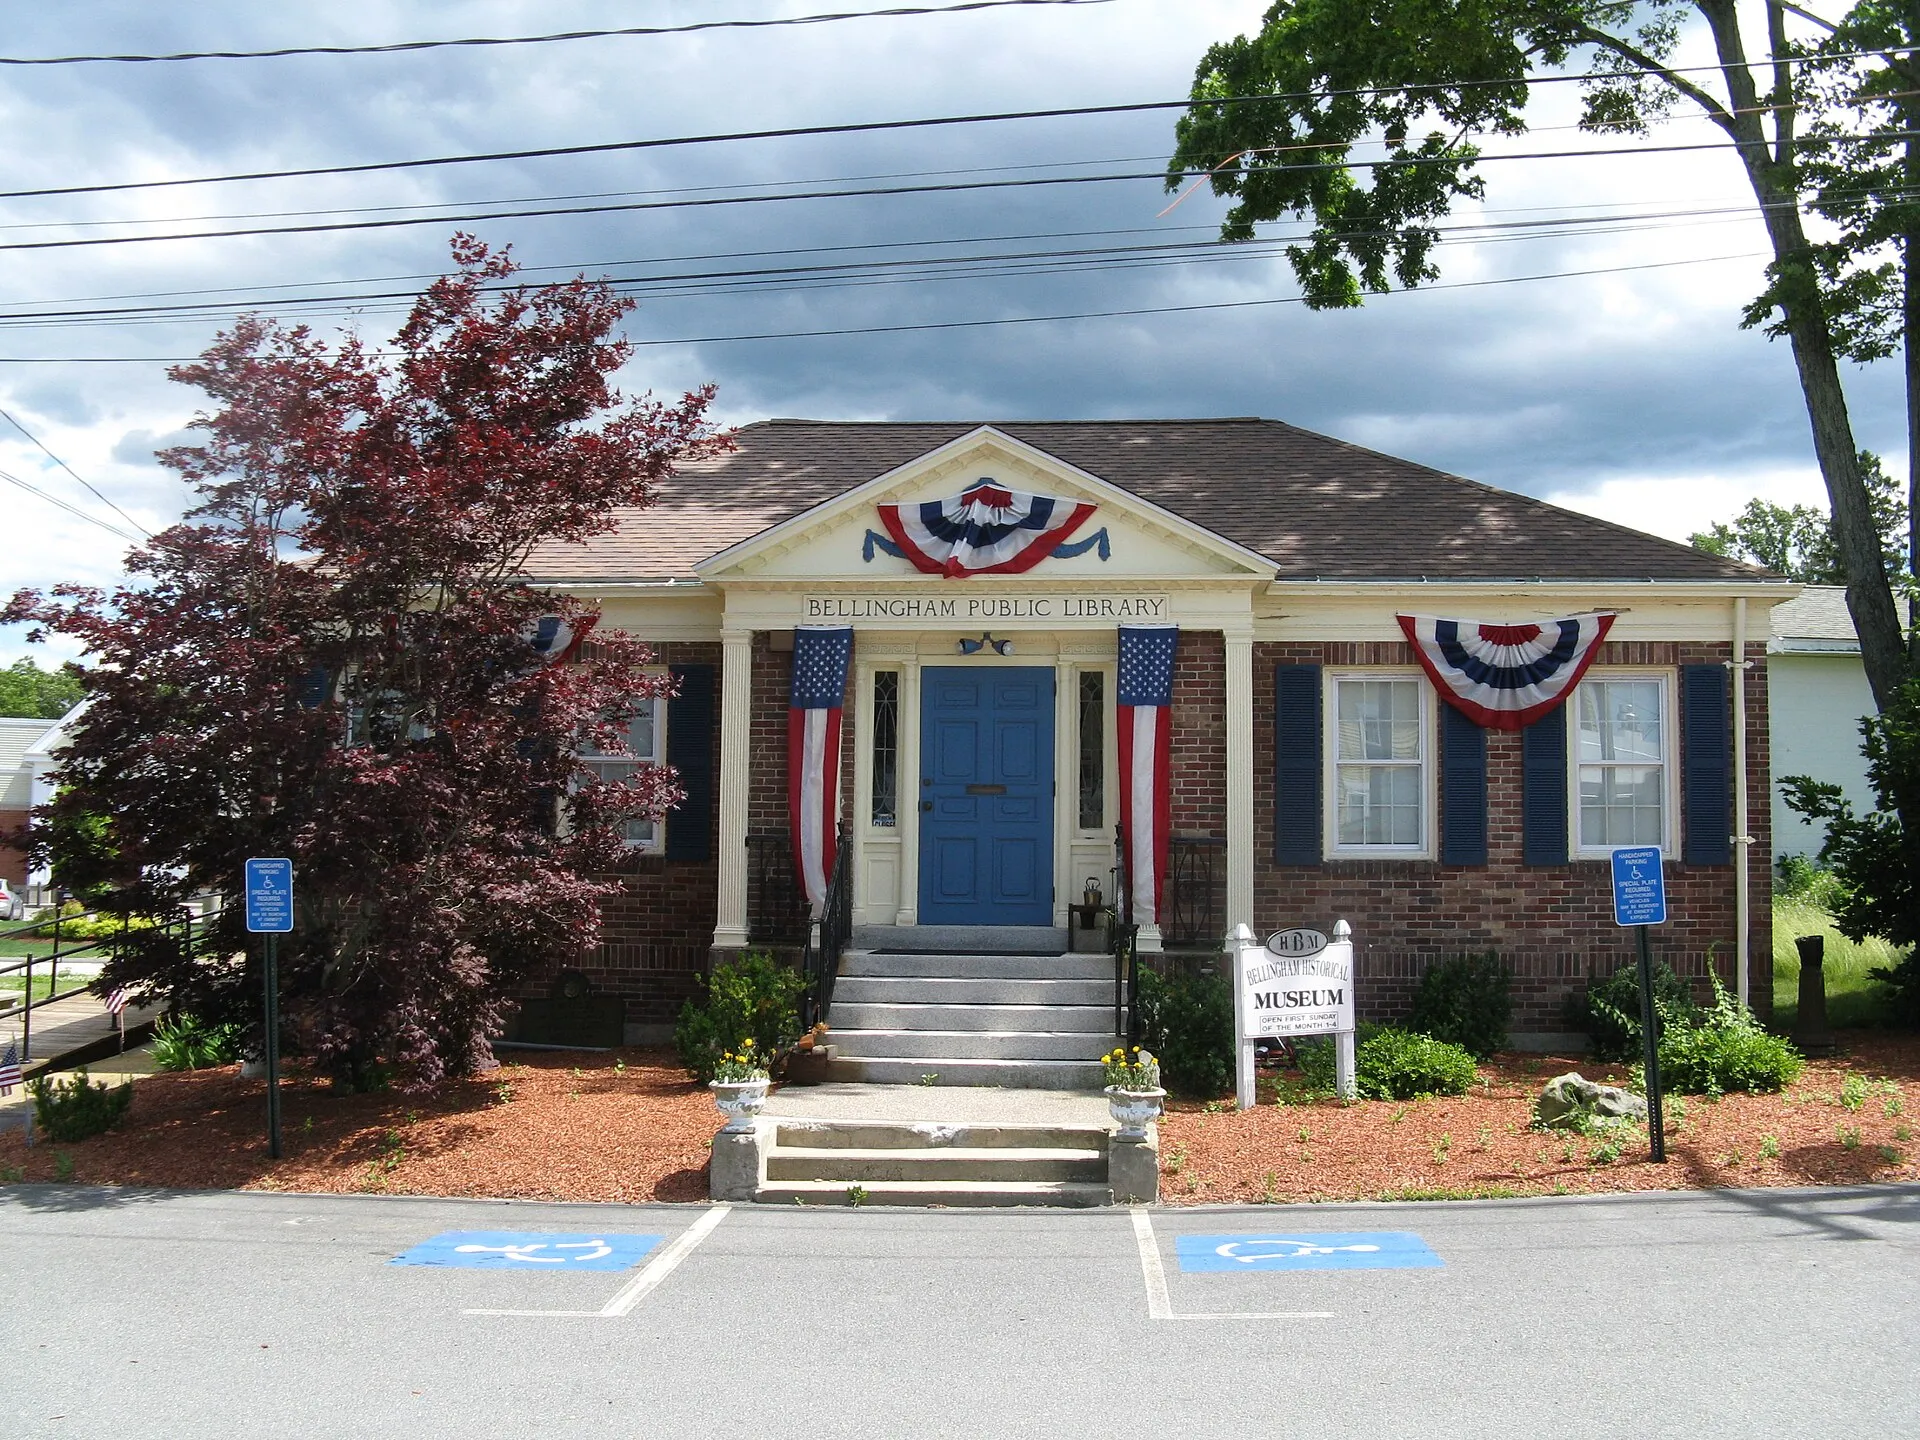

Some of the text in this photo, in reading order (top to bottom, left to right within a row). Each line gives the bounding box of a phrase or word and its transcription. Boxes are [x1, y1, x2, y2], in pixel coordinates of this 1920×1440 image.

[809, 598, 1164, 617] BELLINGHAM PUBLIC LIBRARY
[1246, 959, 1348, 986] BELLINGHAM HISTORICAL
[1254, 988, 1344, 1010] MUSEUM
[1310, 1013, 1337, 1021] SUNDAY
